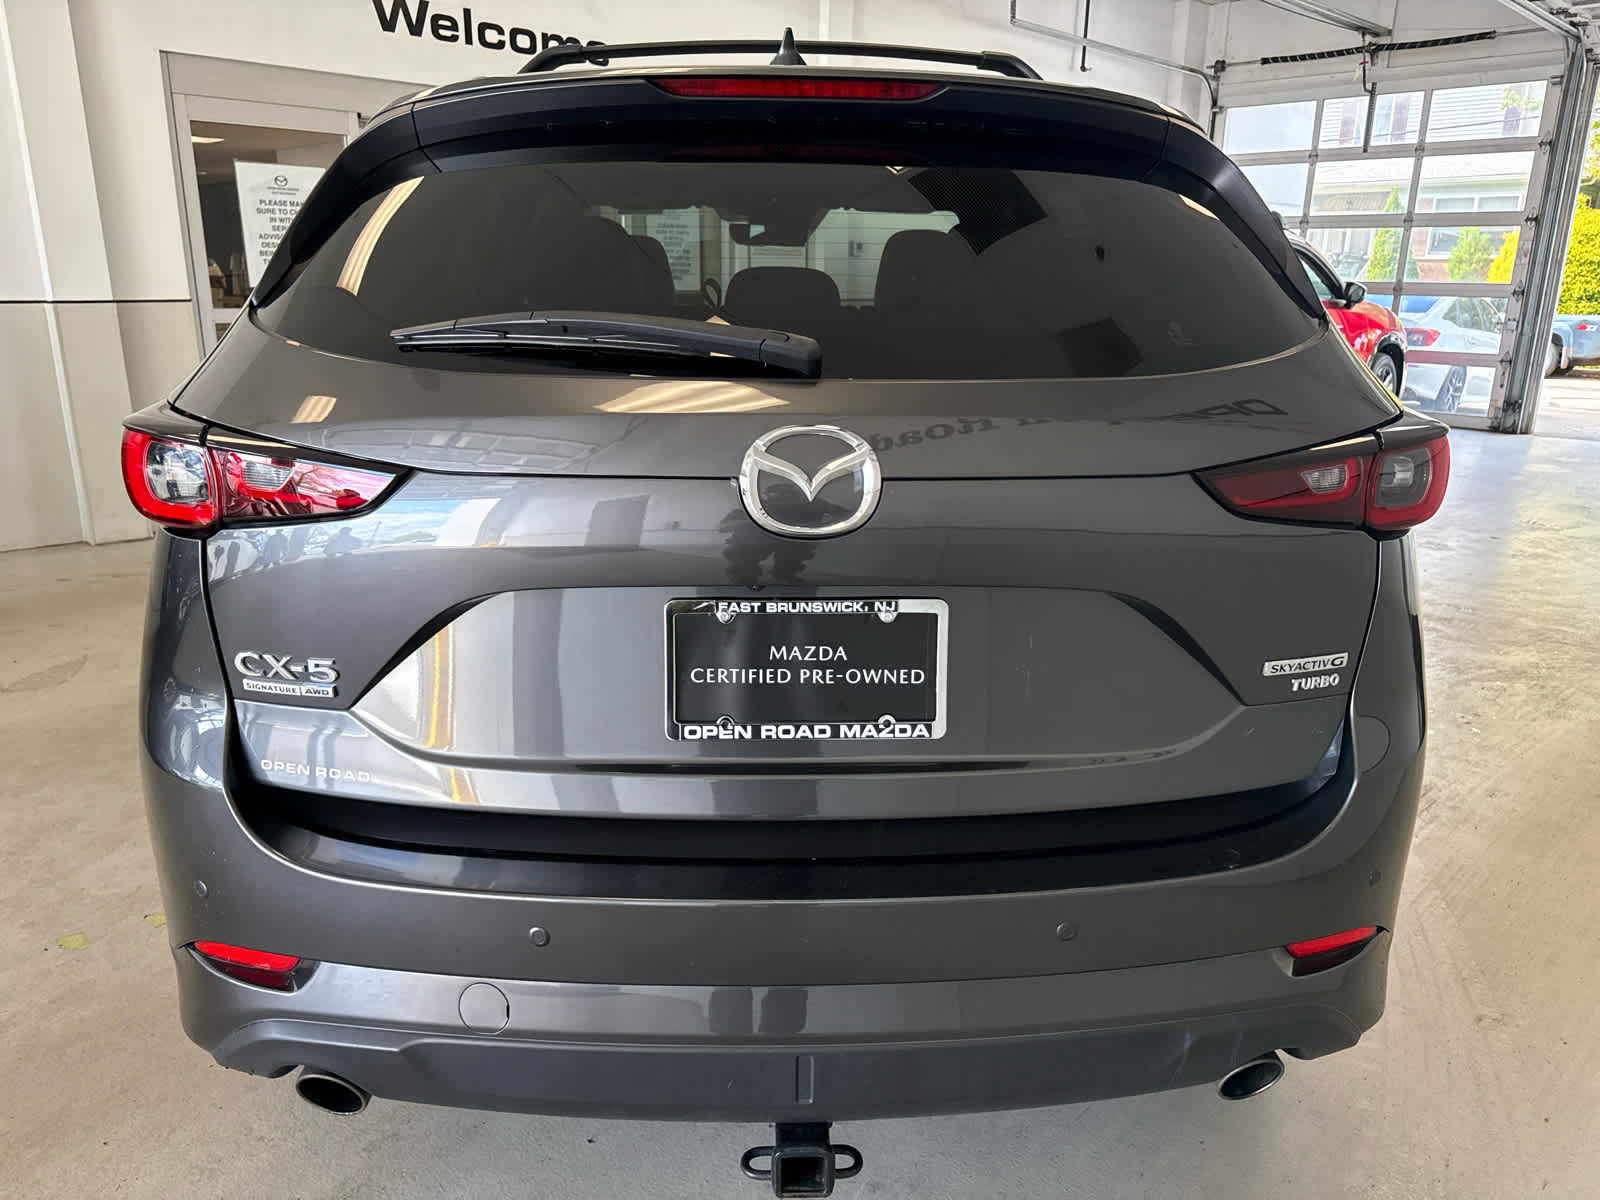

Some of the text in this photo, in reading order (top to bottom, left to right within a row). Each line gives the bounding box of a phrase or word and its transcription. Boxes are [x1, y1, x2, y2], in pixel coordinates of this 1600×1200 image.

[874, 601, 896, 612] NJ
[769, 645, 848, 661] MAZDA
[234, 651, 339, 683] CX-5
[690, 668, 925, 685] CERTIFIED PRE-OWNED
[1291, 673, 1340, 691] TURBO
[246, 682, 330, 696] SIGNATURE AWD
[683, 724, 930, 740] OPEN ROAD MAZDA
[260, 759, 370, 783] OPEN ROAD
